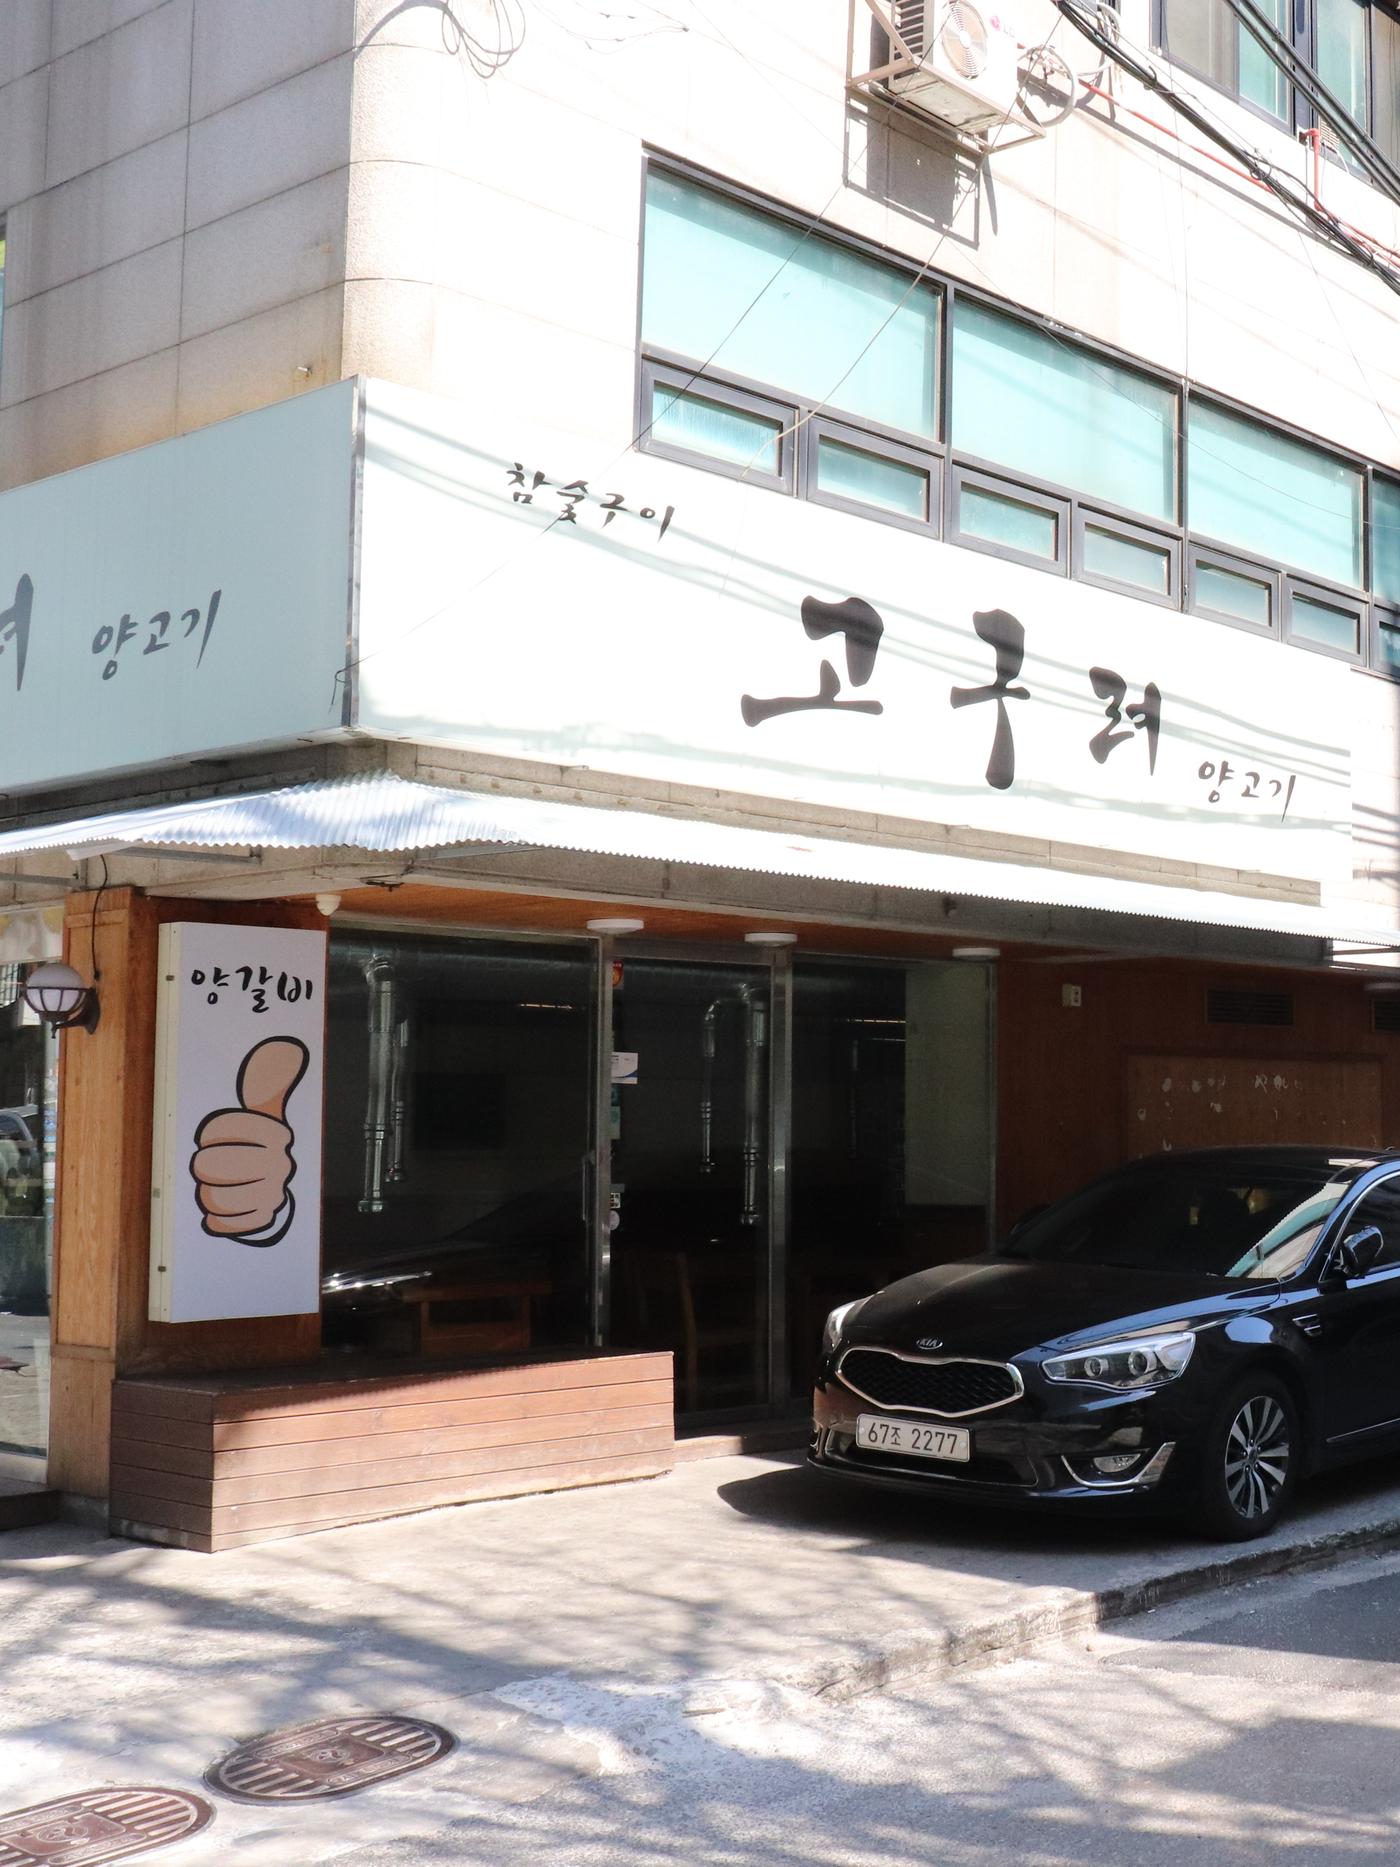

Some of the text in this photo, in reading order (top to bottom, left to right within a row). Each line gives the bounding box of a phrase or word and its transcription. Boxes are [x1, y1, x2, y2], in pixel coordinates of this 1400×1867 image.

[506, 462, 675, 544] 참숯구이
[91, 588, 223, 681] 양고기
[740, 595, 1297, 824] 고구려 양고기
[190, 965, 313, 1014] 양갈비
[868, 1422, 958, 1454] 67조 2277
